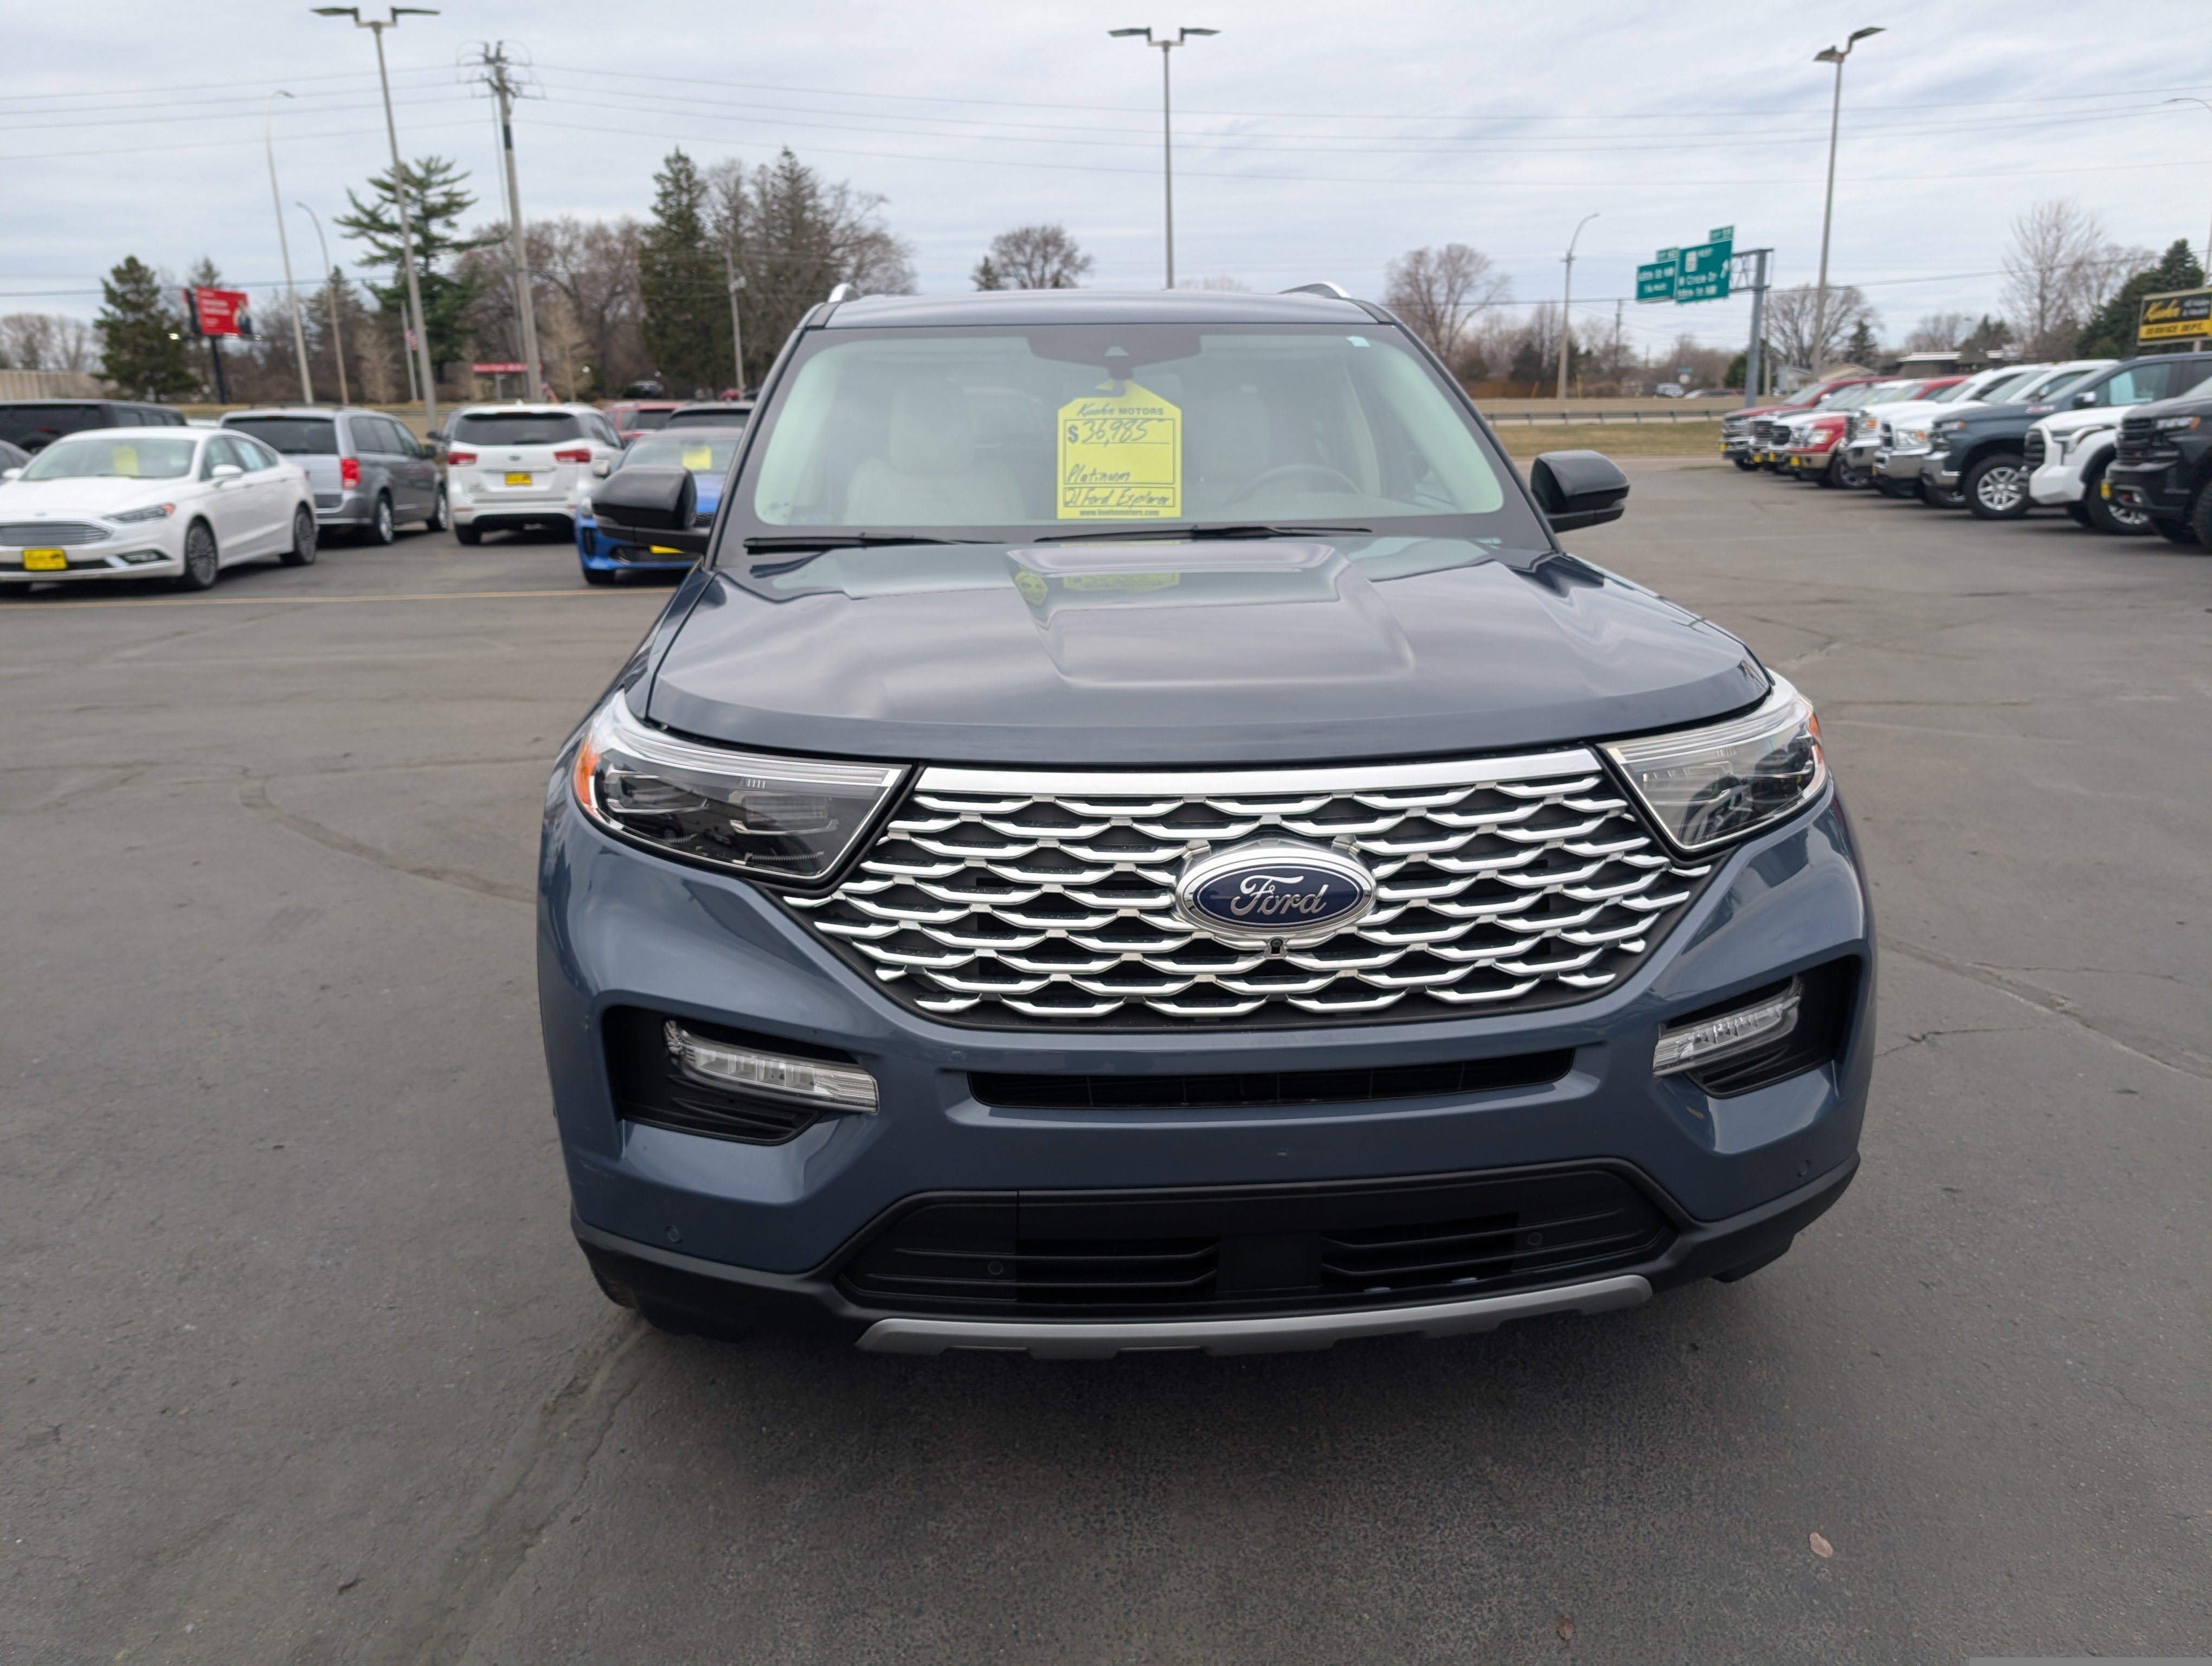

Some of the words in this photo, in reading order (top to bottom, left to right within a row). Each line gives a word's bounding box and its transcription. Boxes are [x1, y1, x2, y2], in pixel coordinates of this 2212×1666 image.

[1067, 464, 1130, 483] Platinum
[1082, 488, 1115, 506] Ford
[1116, 488, 1170, 508] Explorer
[1230, 875, 1329, 916] Ford
